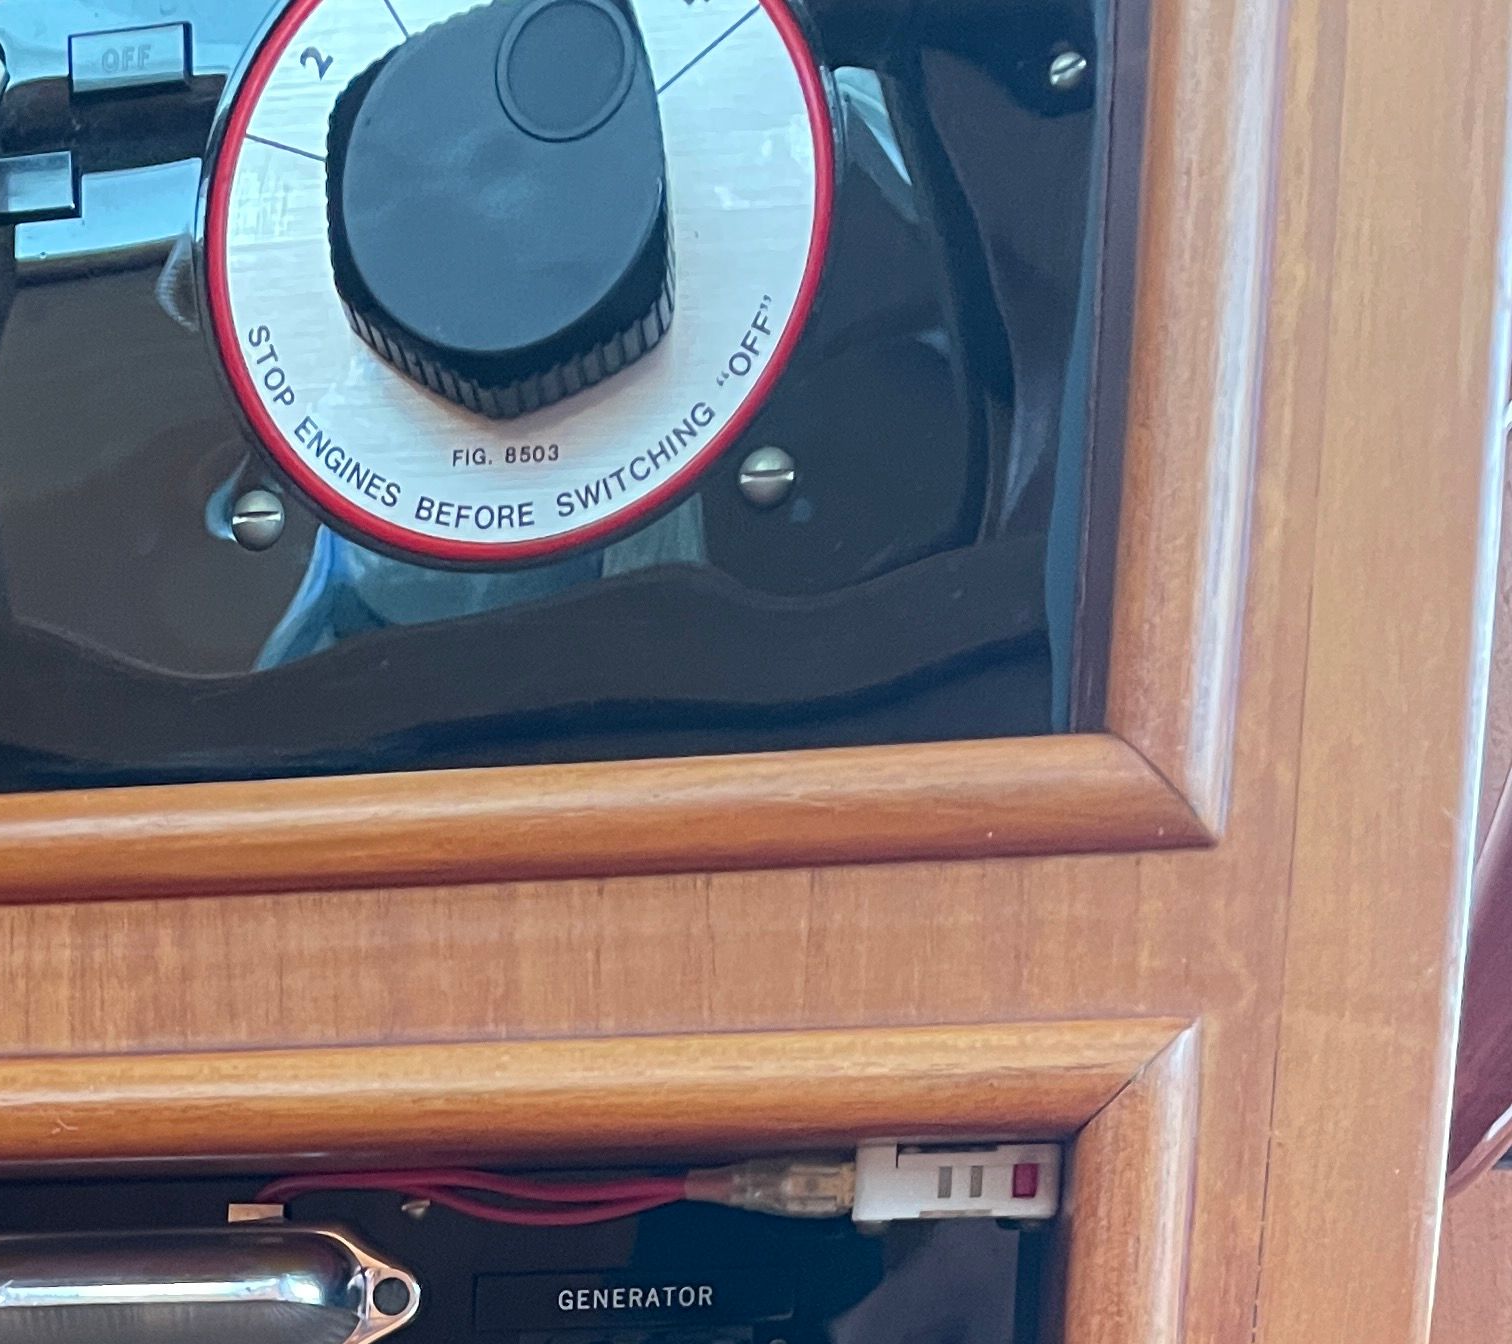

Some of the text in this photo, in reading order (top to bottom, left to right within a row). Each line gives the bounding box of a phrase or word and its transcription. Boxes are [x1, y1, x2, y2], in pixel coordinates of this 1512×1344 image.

[102, 45, 152, 72] OFF
[300, 47, 333, 80] 2
[248, 324, 295, 406] STOP
[294, 416, 401, 507] ENGINES
[415, 496, 536, 529] BEFORE
[556, 402, 715, 517] SWITCHING
[452, 444, 560, 467] FIG. 8503
[558, 1286, 713, 1311] GENERATOR
